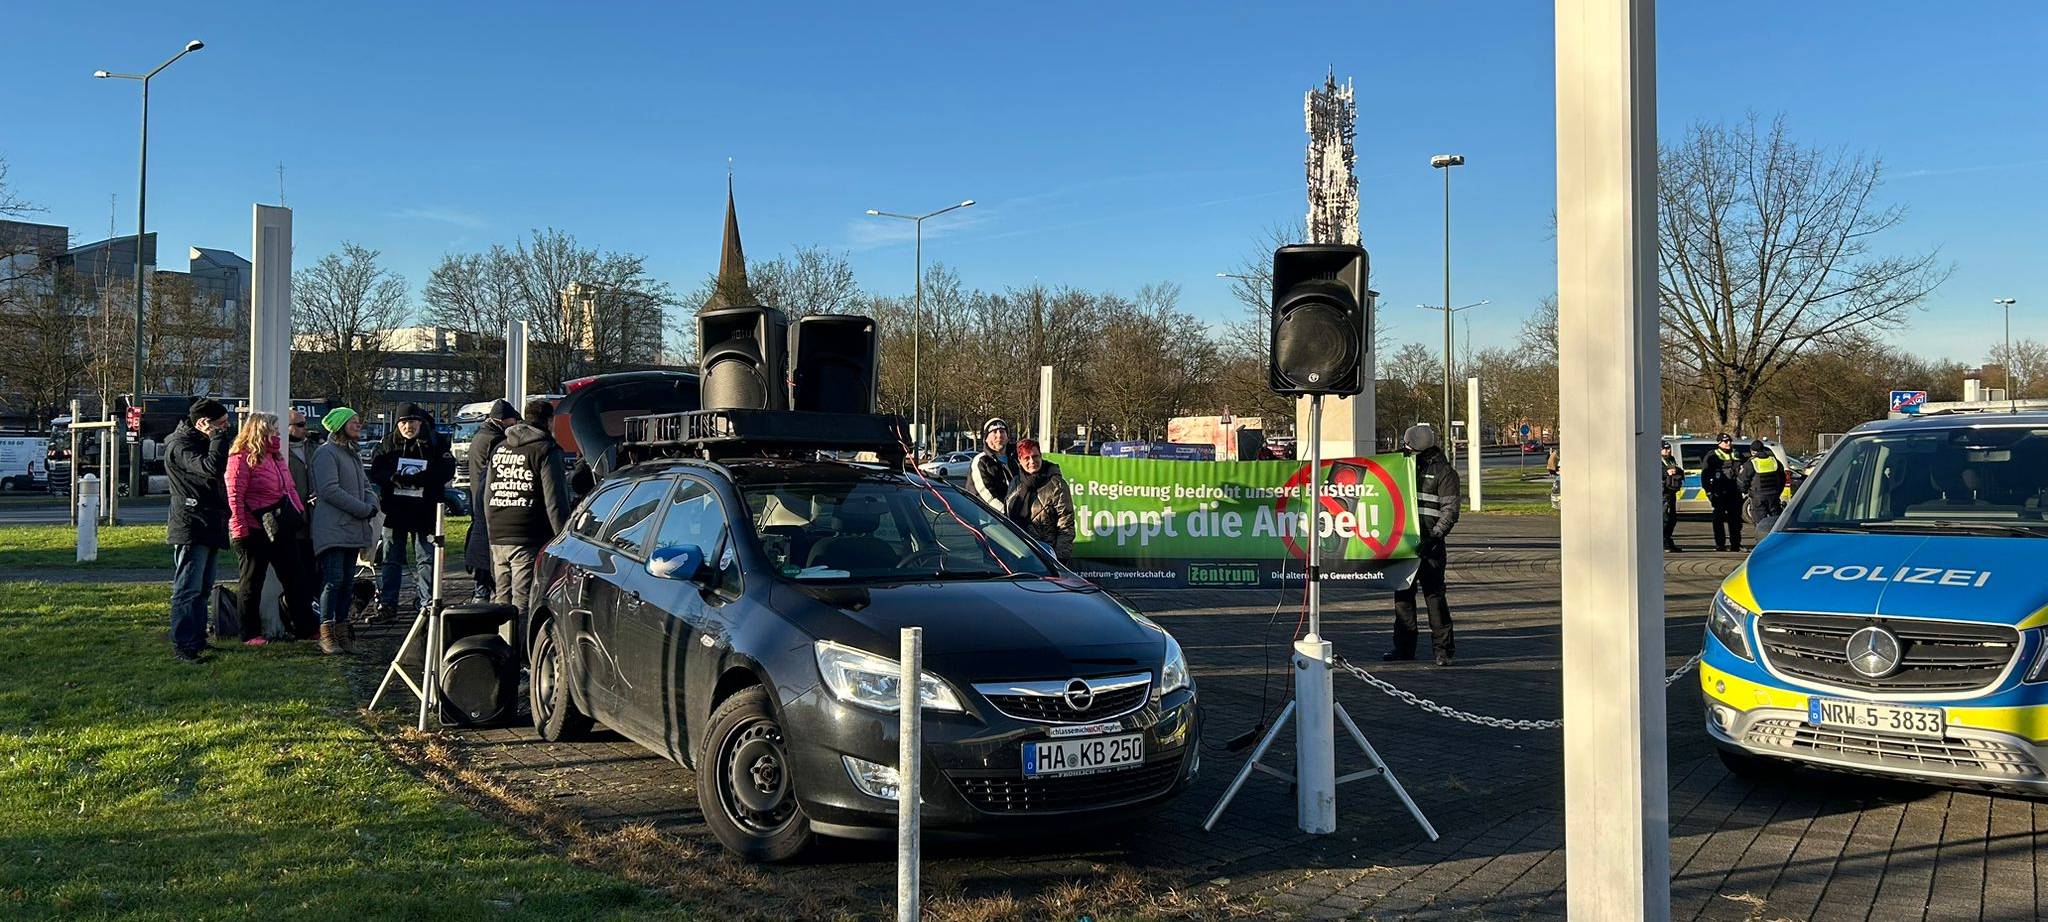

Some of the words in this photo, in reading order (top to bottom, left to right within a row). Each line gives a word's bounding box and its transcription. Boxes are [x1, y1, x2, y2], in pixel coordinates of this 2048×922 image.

[297, 405, 320, 417] BIL
[496, 465, 534, 480] Sekte
[1070, 479, 1085, 496] ie
[1089, 481, 1171, 501] Regierung
[1175, 483, 1241, 499] bedroht
[1245, 486, 1300, 498] unsere
[1075, 503, 1178, 546] toppt
[1187, 501, 1243, 538] die
[1191, 566, 1255, 582] Zentrum
[1330, 571, 1384, 580] Gewerkschaft
[1801, 565, 1991, 587] POLIZEI
[1821, 702, 1855, 725] NRW
[1866, 709, 1940, 733] 5-3833
[1038, 745, 1066, 770] HA
[1080, 742, 1105, 767] KB
[1109, 738, 1142, 763] 250
